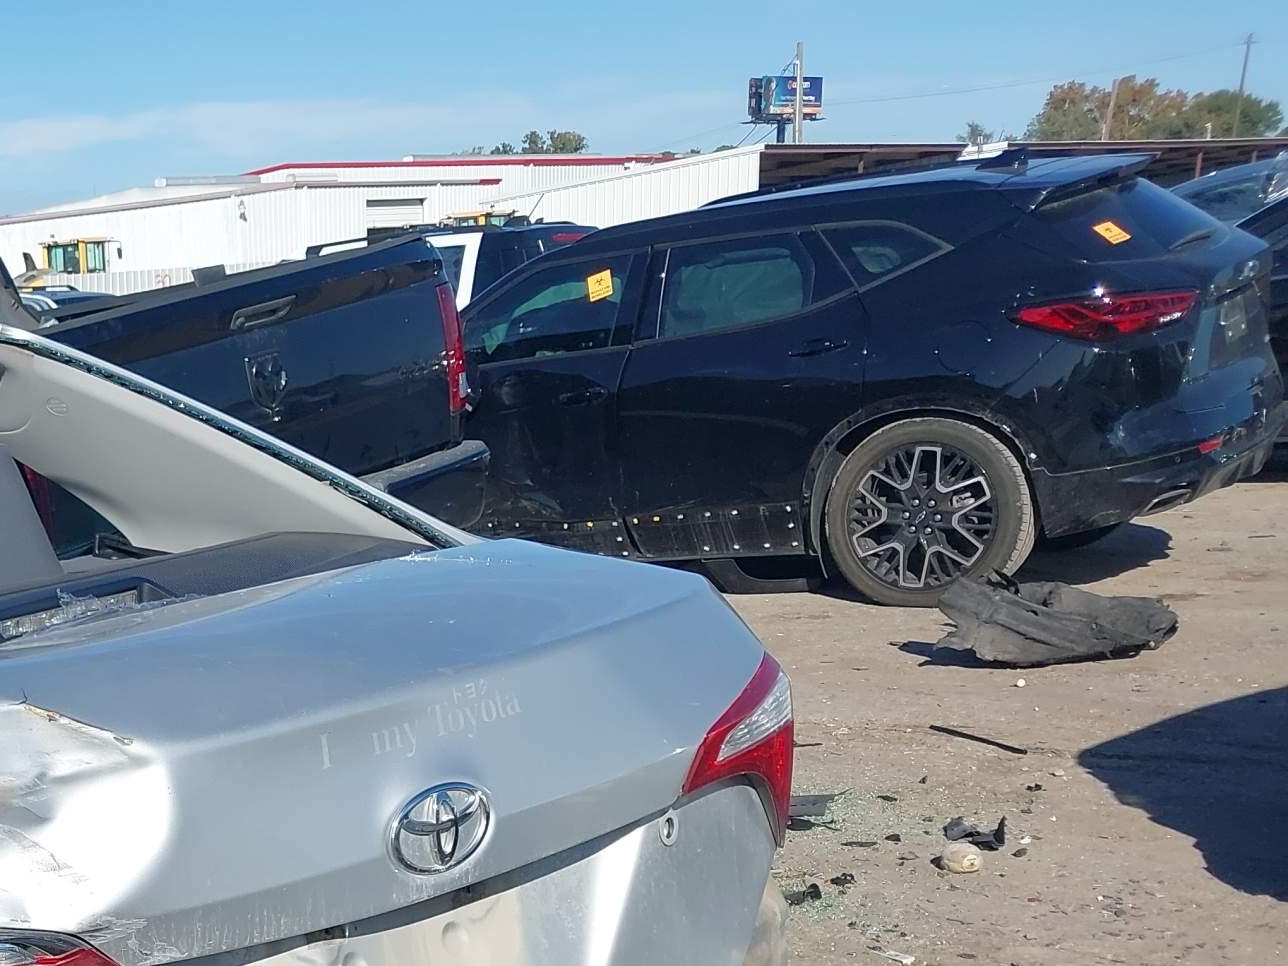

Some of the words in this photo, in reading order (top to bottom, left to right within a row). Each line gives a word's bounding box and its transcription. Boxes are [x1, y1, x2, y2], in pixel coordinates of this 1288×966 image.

[320, 733, 332, 769] I
[371, 721, 417, 757] my
[427, 691, 522, 738] Toyota
